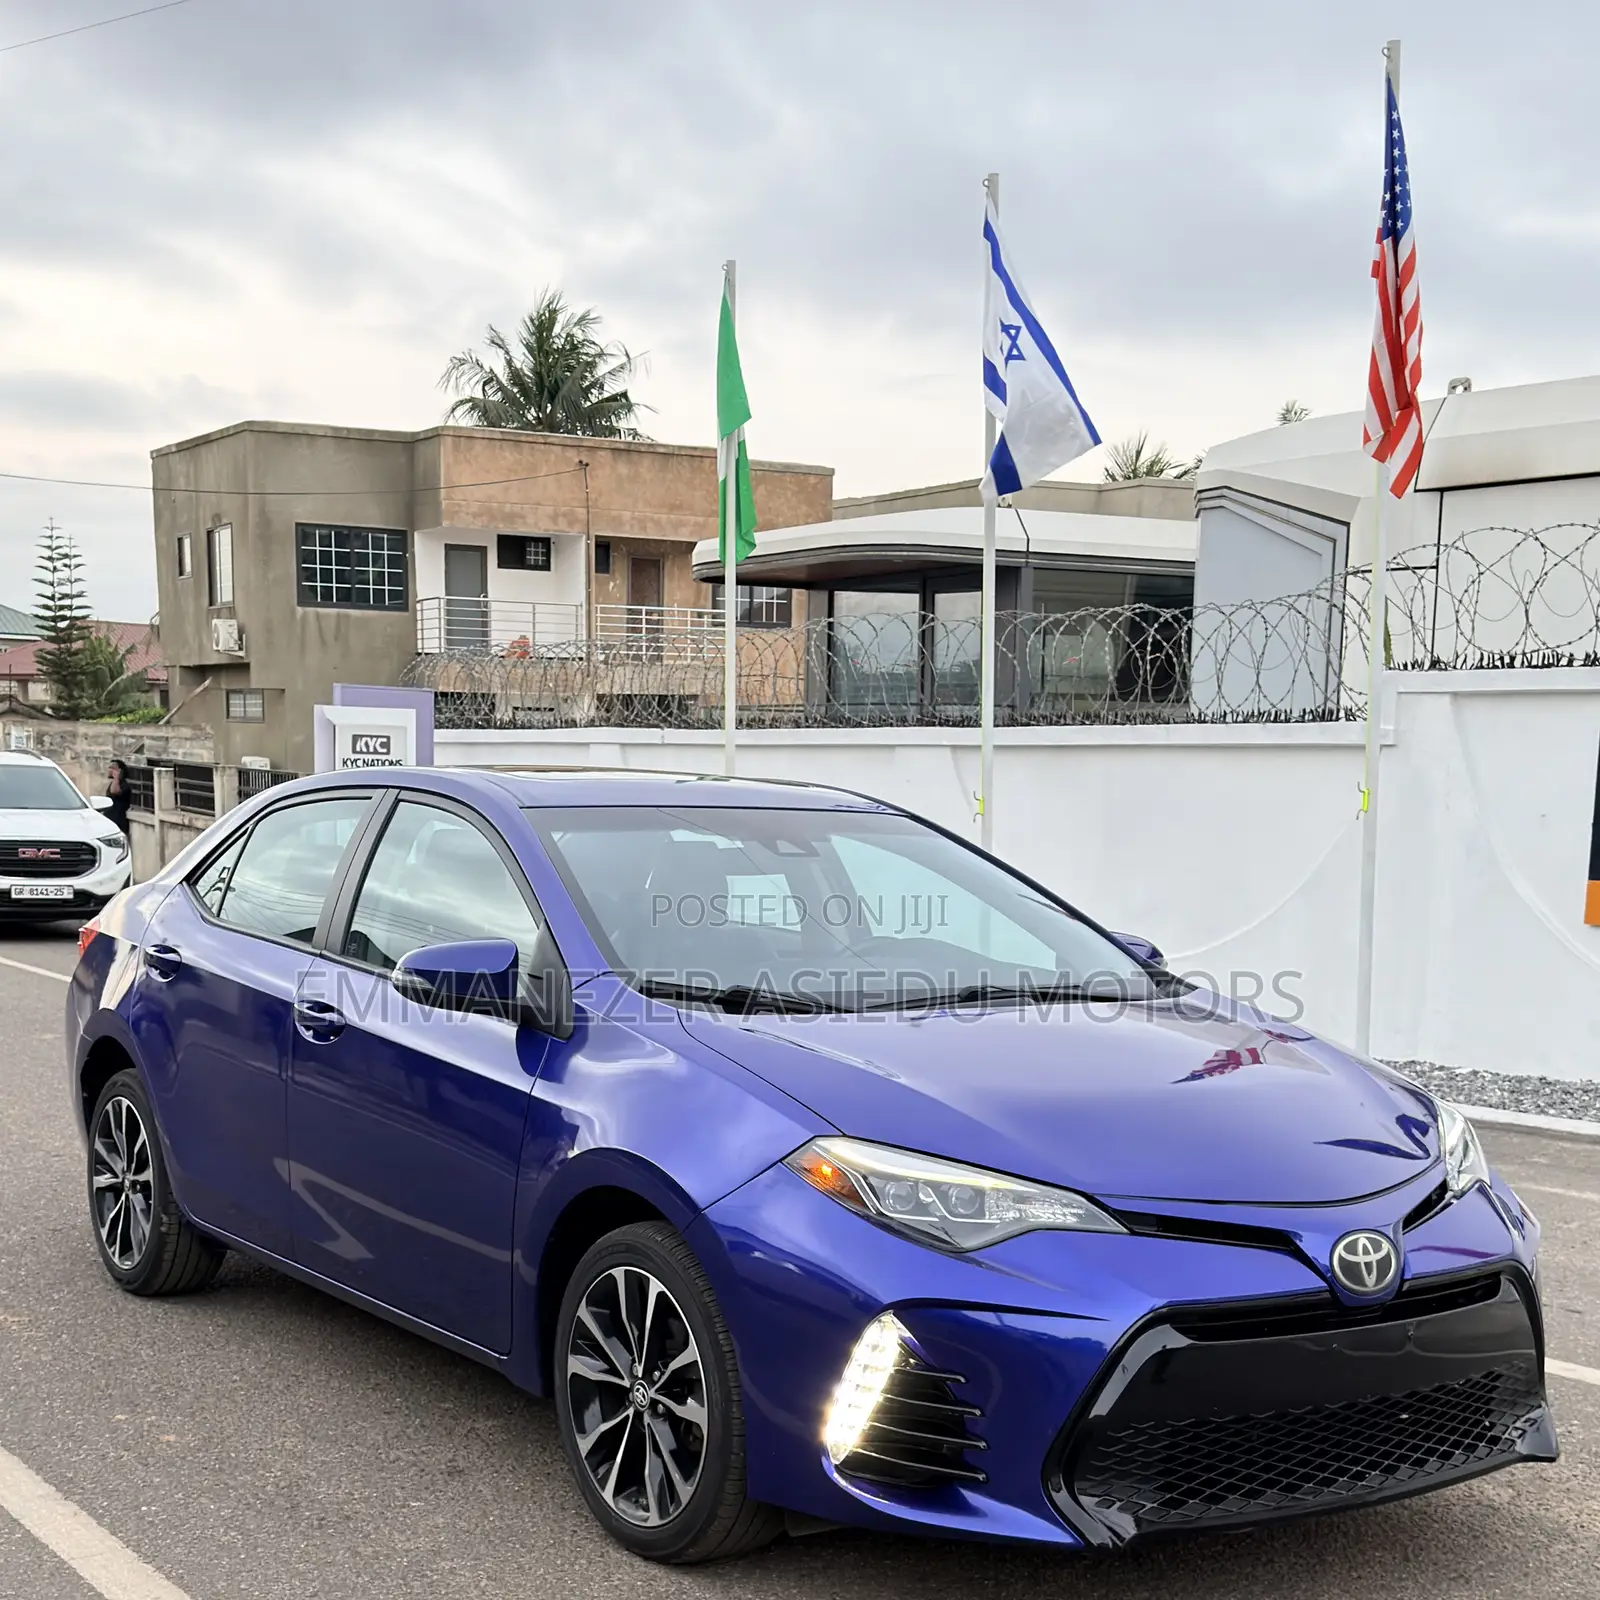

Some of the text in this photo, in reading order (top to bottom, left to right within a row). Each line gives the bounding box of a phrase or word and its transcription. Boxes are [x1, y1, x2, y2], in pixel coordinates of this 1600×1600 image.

[355, 736, 388, 753] KYC
[342, 757, 403, 768] KYC NATIONS
[18, 848, 61, 859] GMC
[14, 887, 25, 896] GR
[29, 887, 65, 896] 8141-25
